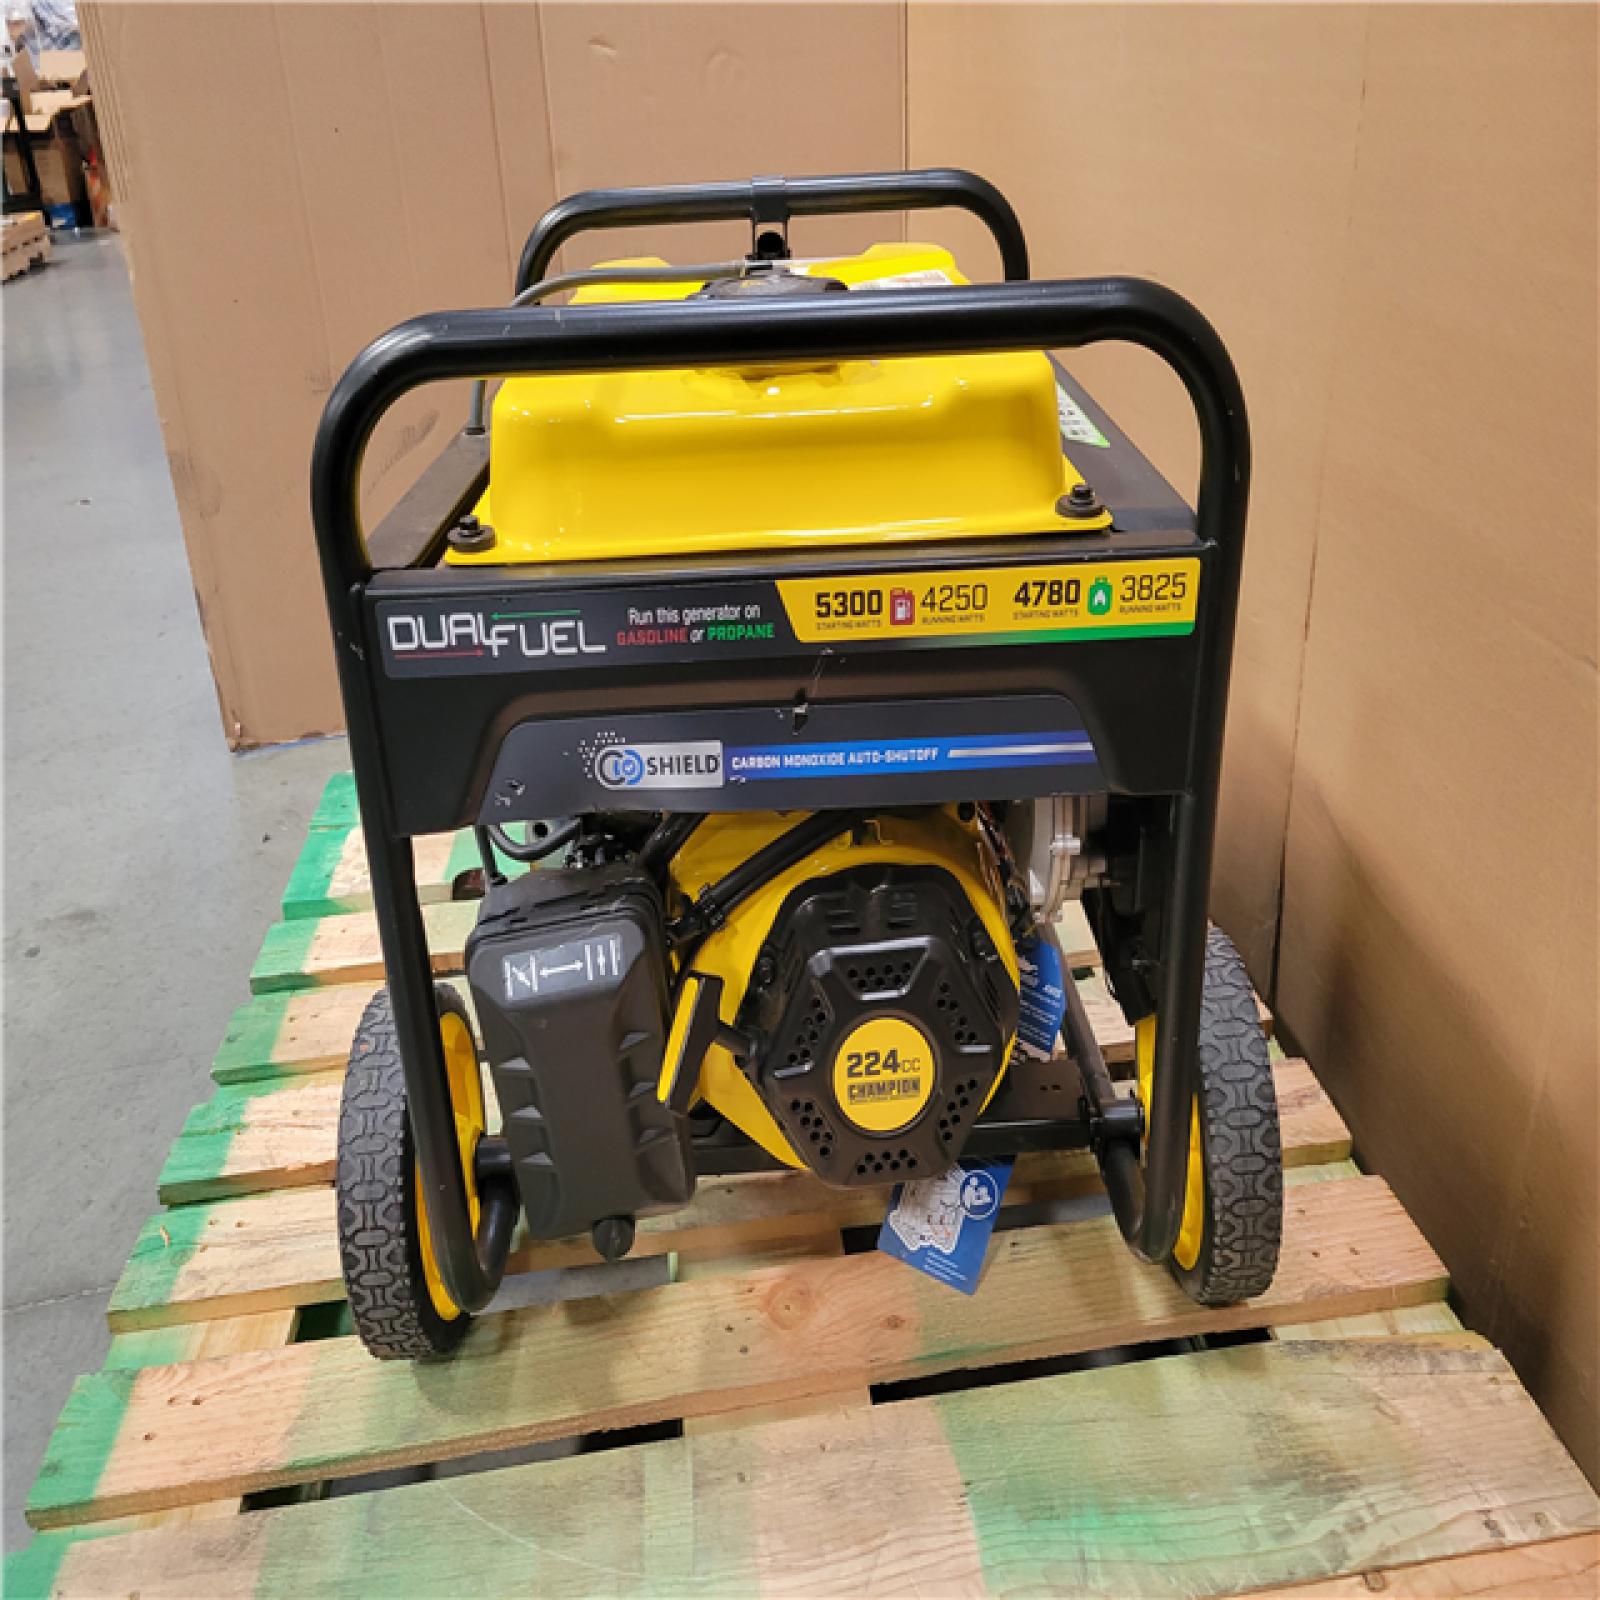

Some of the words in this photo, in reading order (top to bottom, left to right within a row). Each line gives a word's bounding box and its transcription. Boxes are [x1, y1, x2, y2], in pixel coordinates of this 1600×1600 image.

[815, 589, 883, 618] 5300
[920, 582, 988, 613] 4250
[1013, 579, 1081, 608] 4780
[1120, 571, 1188, 603] 3825
[628, 607, 653, 625] Run
[656, 607, 680, 623] this
[683, 604, 741, 625] generator
[744, 604, 761, 619] on
[816, 620, 853, 631] STARTING
[1013, 611, 1051, 621] STARTING
[617, 627, 688, 645] GASOLINE
[690, 629, 705, 643] or
[707, 623, 775, 641] PROPANE
[646, 754, 720, 776] SHIELD
[731, 754, 781, 770] CARBON
[783, 751, 846, 769] MONOXIDE
[848, 746, 939, 765] AUTO-SHUTOFF
[847, 1077, 921, 1101] CHAMPION
